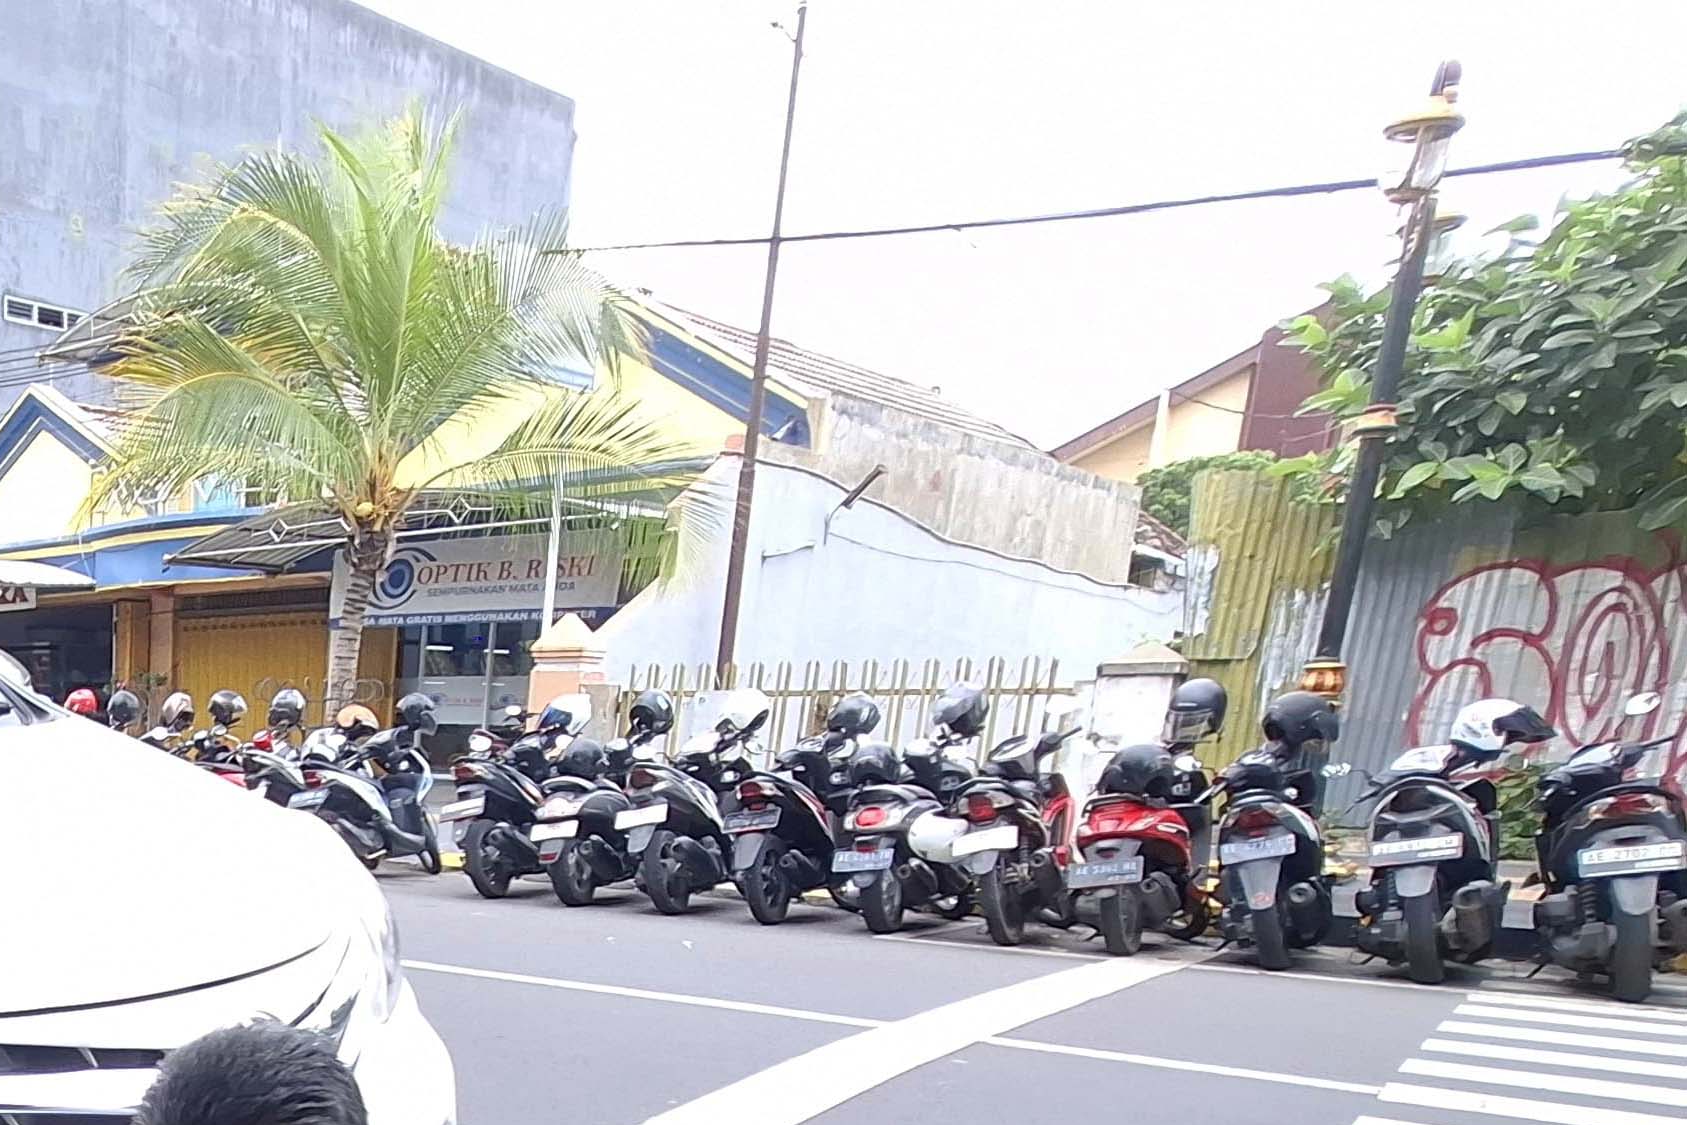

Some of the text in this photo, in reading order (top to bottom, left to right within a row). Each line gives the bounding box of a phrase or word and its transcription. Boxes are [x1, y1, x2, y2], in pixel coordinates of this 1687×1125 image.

[417, 554, 596, 585] OPTIK B. RSKI
[427, 585, 506, 598] SEMPURNAKAN
[508, 582, 538, 593] MATA
[378, 615, 404, 625] MATA
[406, 614, 442, 625] GRATIS
[444, 611, 529, 624] MENGGUNAKAN
